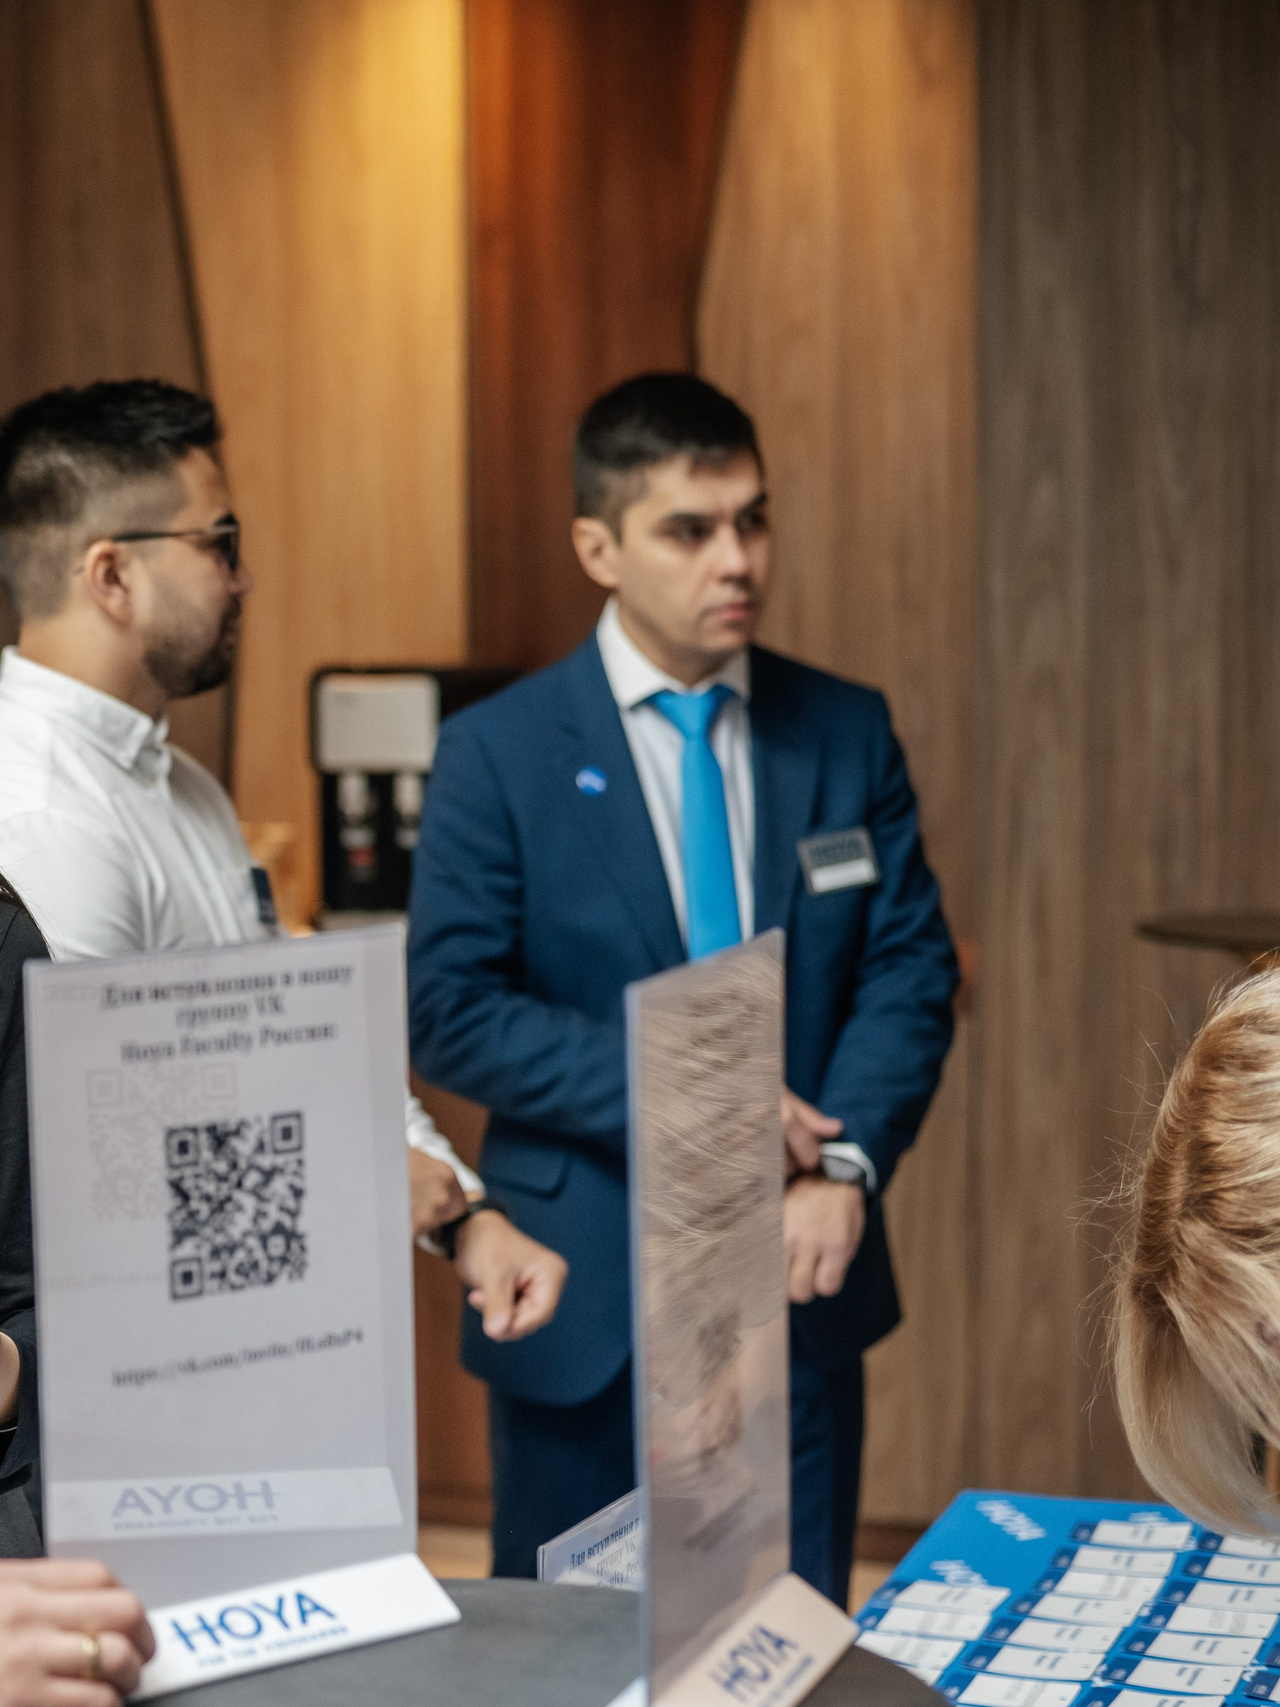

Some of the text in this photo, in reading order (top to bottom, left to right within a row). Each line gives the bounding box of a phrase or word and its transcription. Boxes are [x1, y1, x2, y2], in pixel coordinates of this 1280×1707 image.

[569, 1551, 586, 1575] Для
[587, 1520, 634, 1561] вступления
[171, 1590, 337, 1652] HOYA
